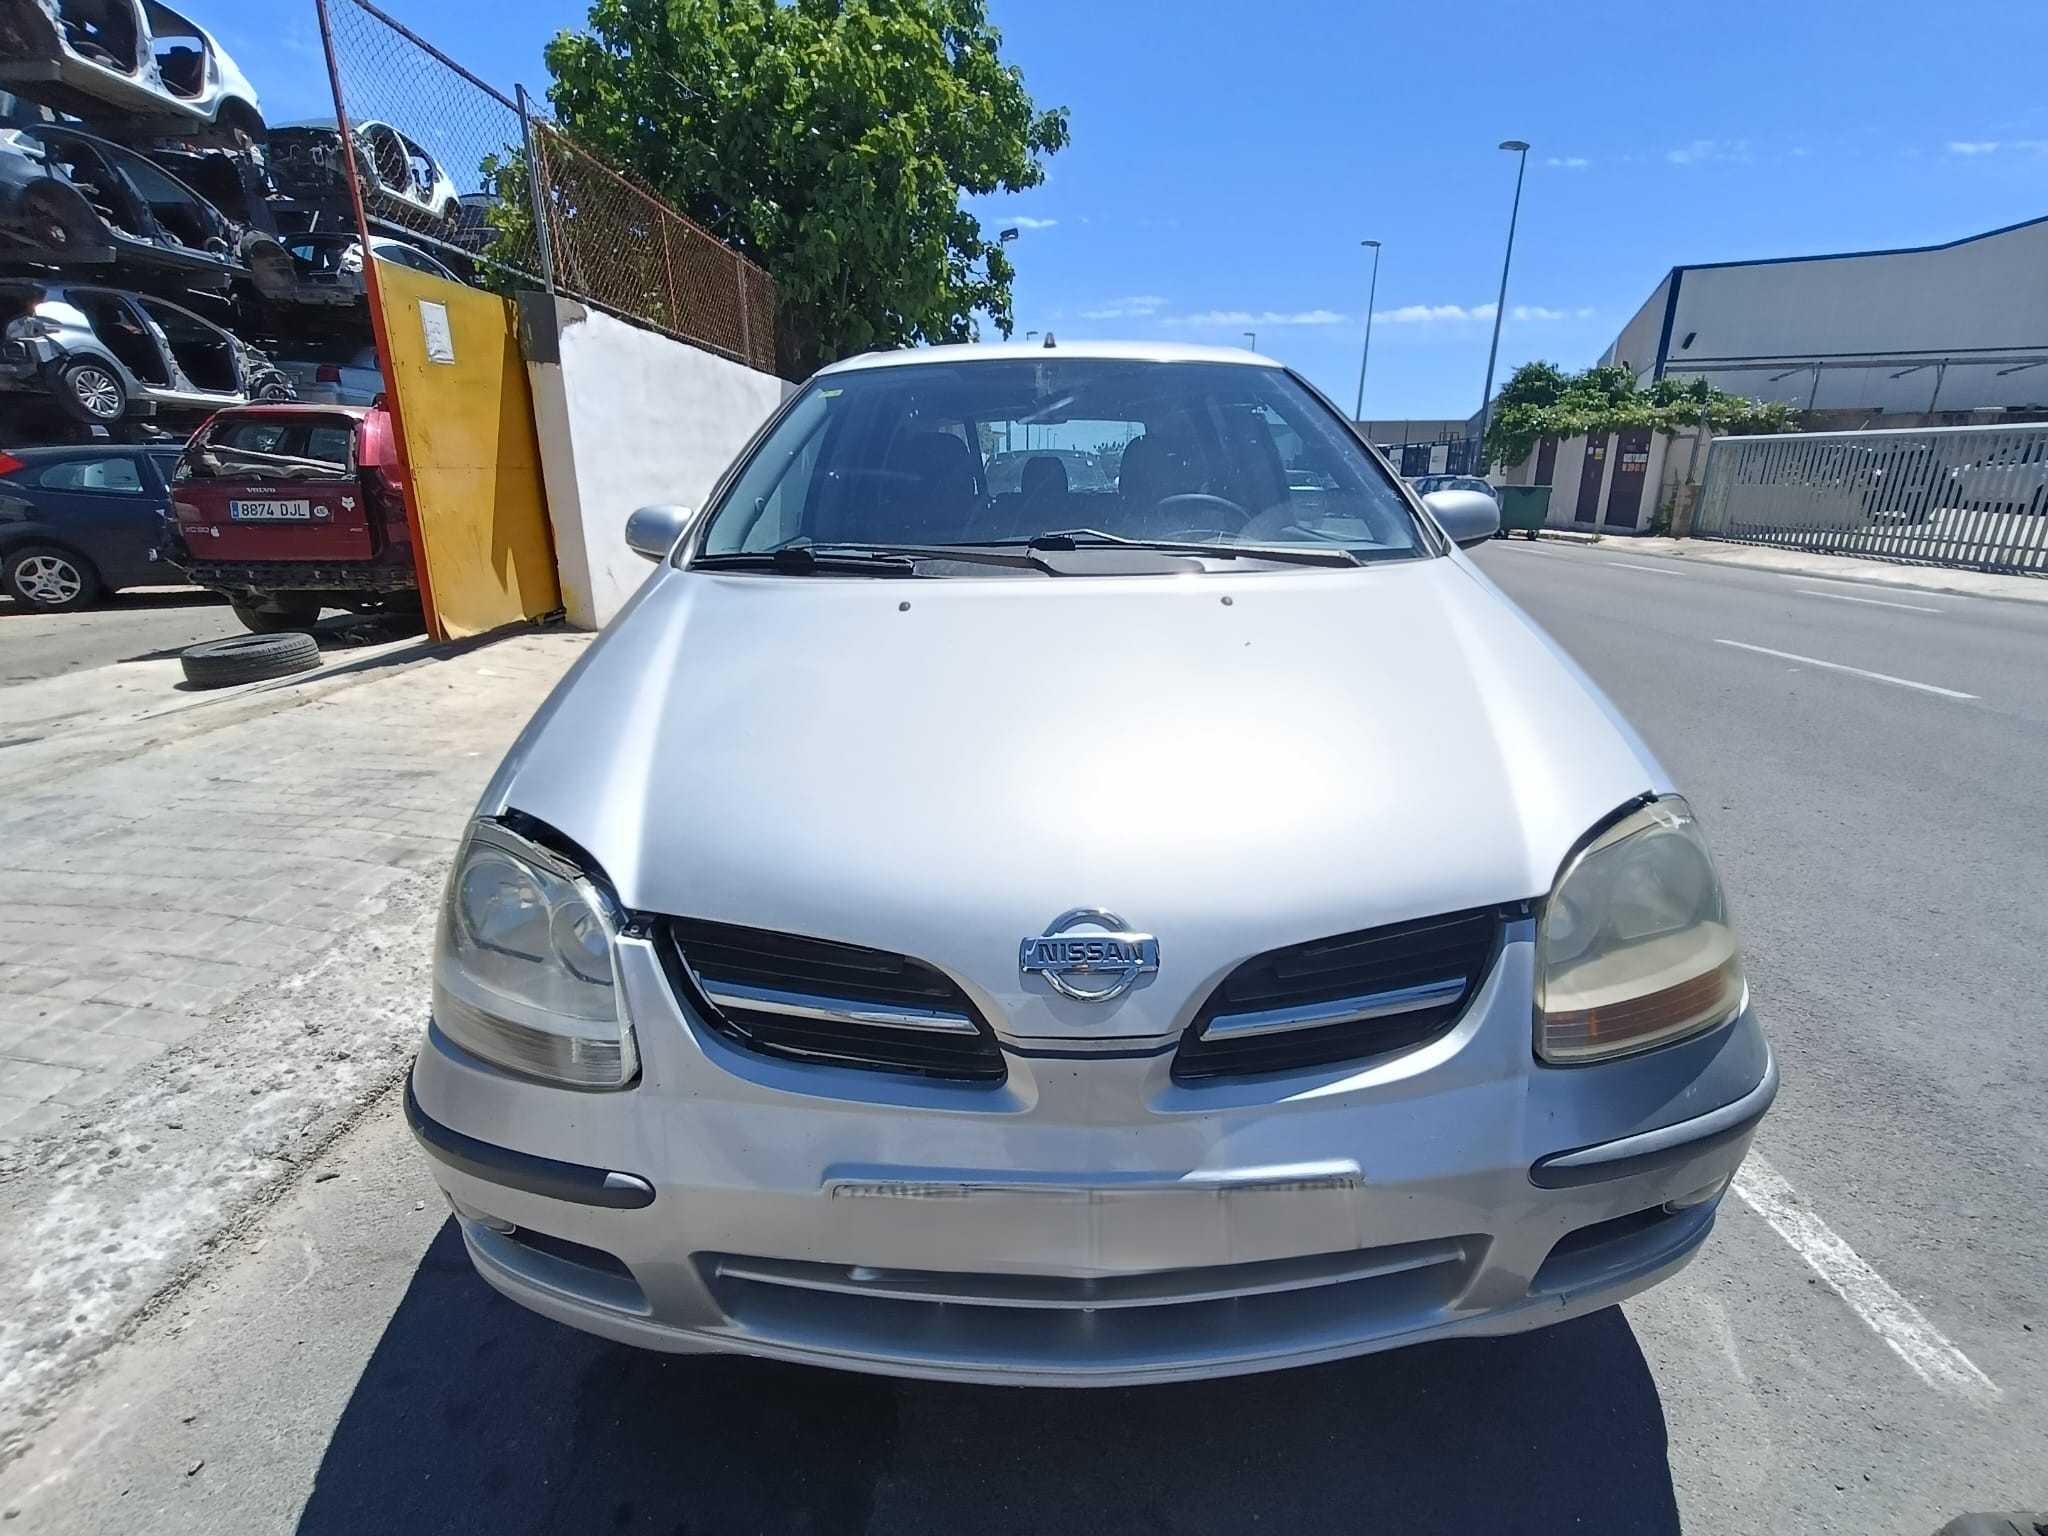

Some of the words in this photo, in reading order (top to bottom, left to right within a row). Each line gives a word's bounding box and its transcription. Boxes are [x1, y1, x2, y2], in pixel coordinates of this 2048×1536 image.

[241, 503, 275, 517] 8874
[280, 503, 306, 517] DJL
[1038, 942, 1144, 963] NISSAN
